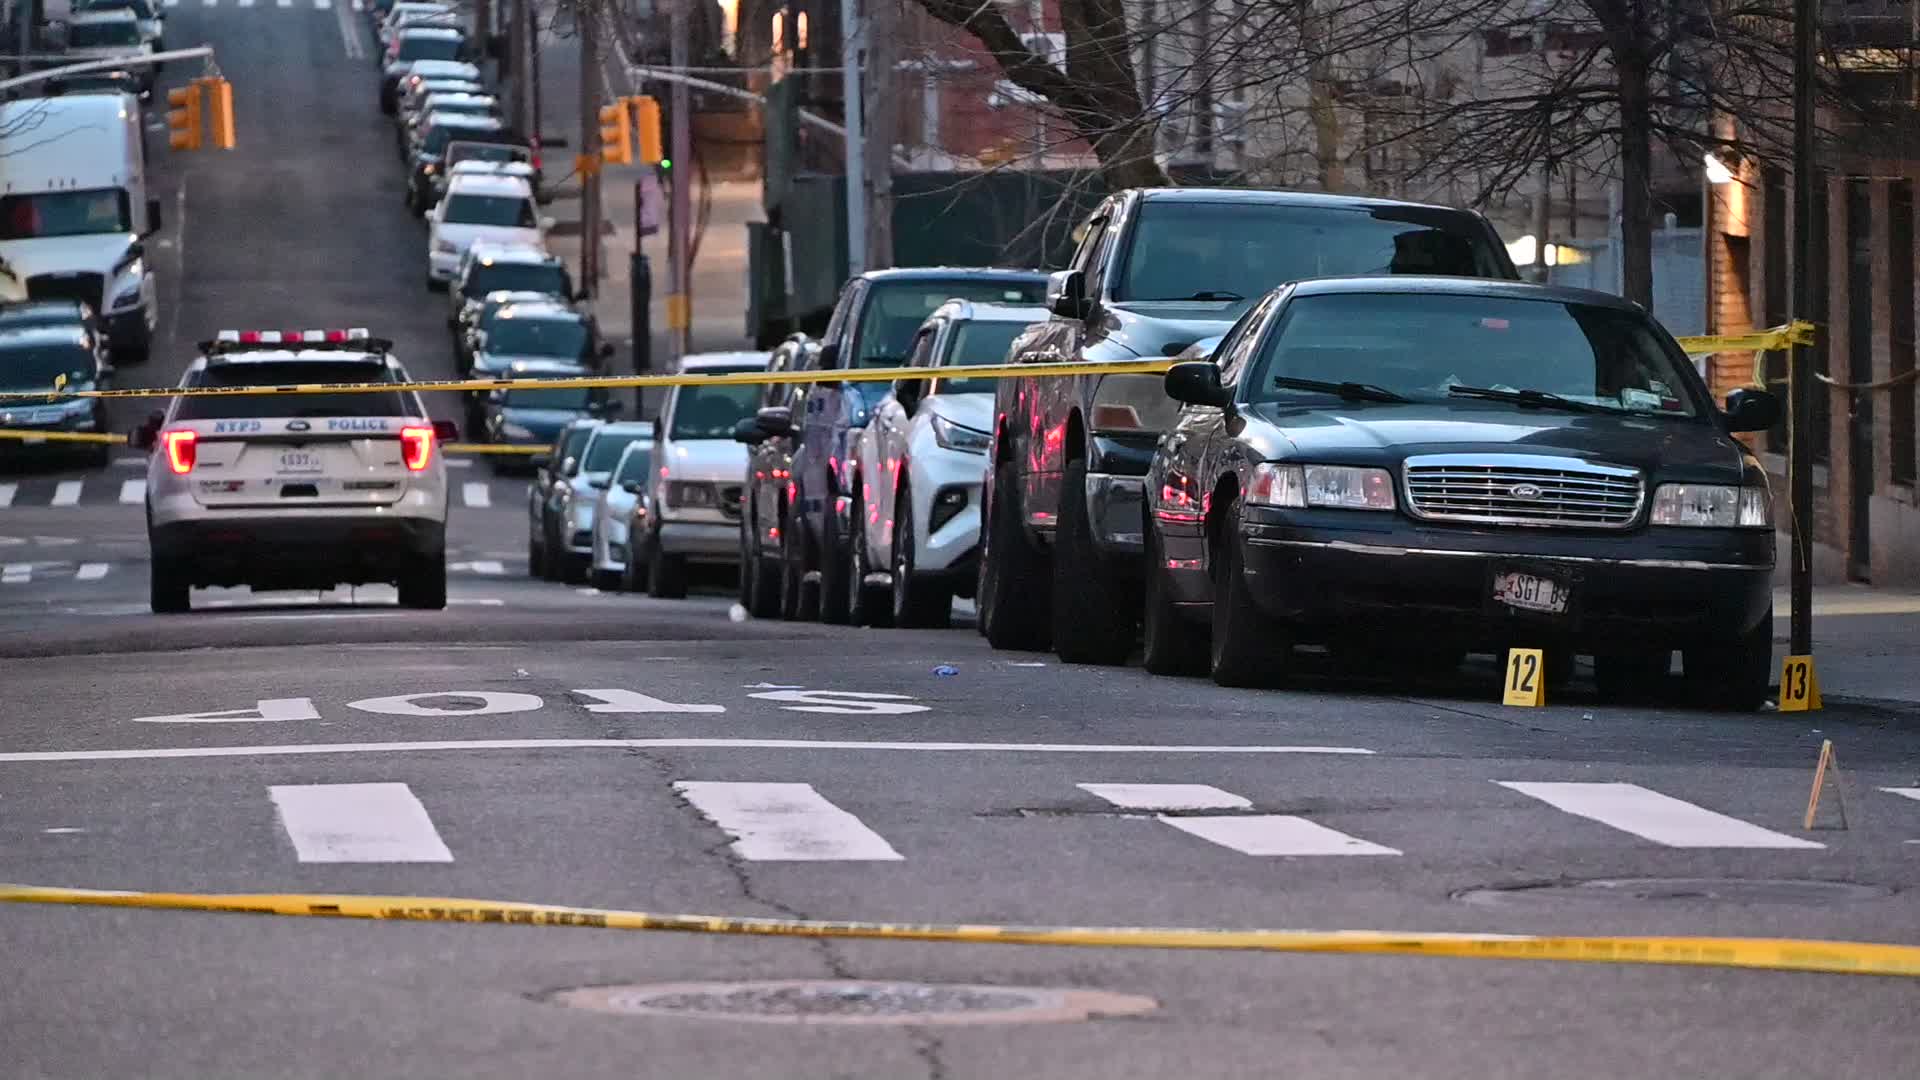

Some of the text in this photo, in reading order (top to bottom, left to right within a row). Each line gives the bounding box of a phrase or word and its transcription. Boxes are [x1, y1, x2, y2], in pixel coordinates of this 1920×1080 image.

[214, 419, 389, 433] NYPD POLICE
[1515, 575, 1543, 602] SGT
[1511, 653, 1537, 693] 12
[1785, 662, 1807, 700] 13
[133, 689, 932, 723] STOP
